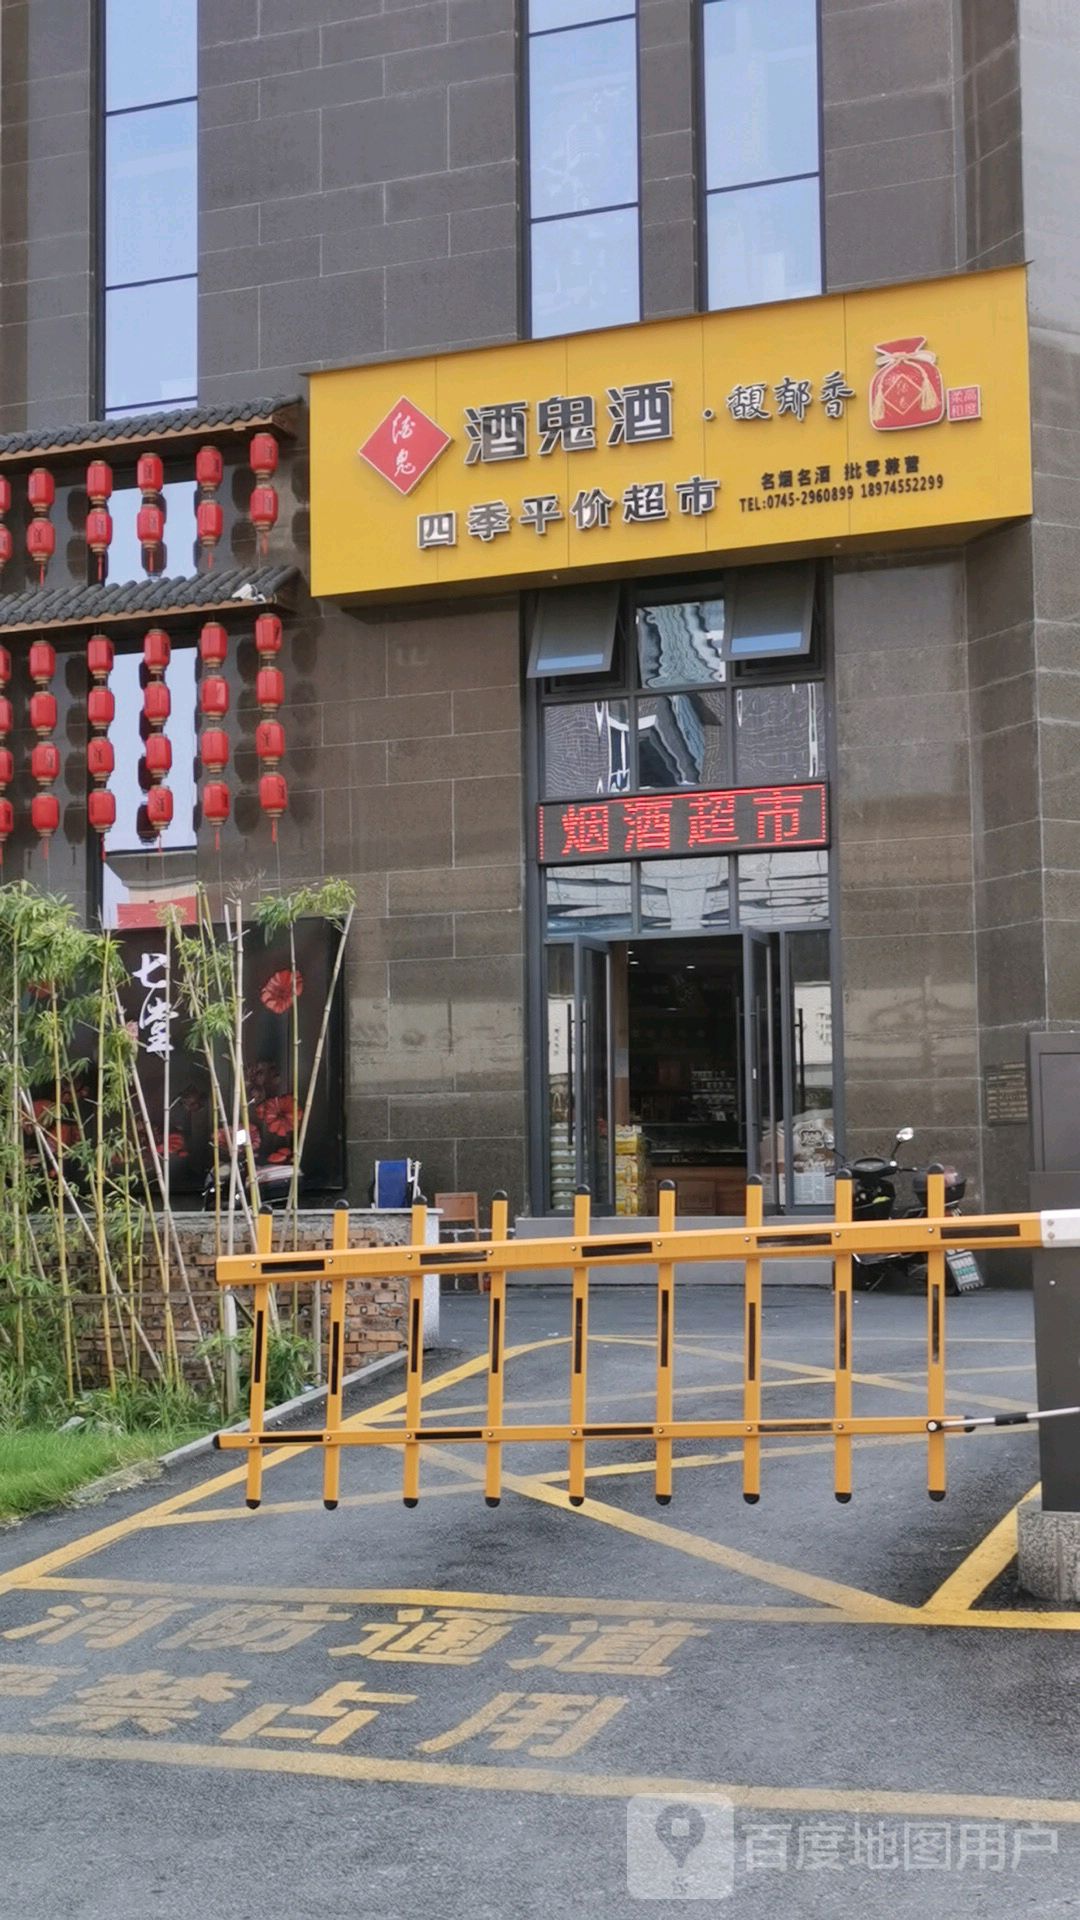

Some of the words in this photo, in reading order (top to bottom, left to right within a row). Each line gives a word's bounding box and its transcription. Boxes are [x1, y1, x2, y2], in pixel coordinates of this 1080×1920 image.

[464, 379, 674, 466] 酒鬼酒
[417, 475, 720, 550] 四季平价超市
[761, 465, 831, 491] 名烟名酒
[861, 474, 944, 499] 18974552299
[561, 791, 803, 855] 烟酒超市
[2, 1596, 711, 1677] 消防通道
